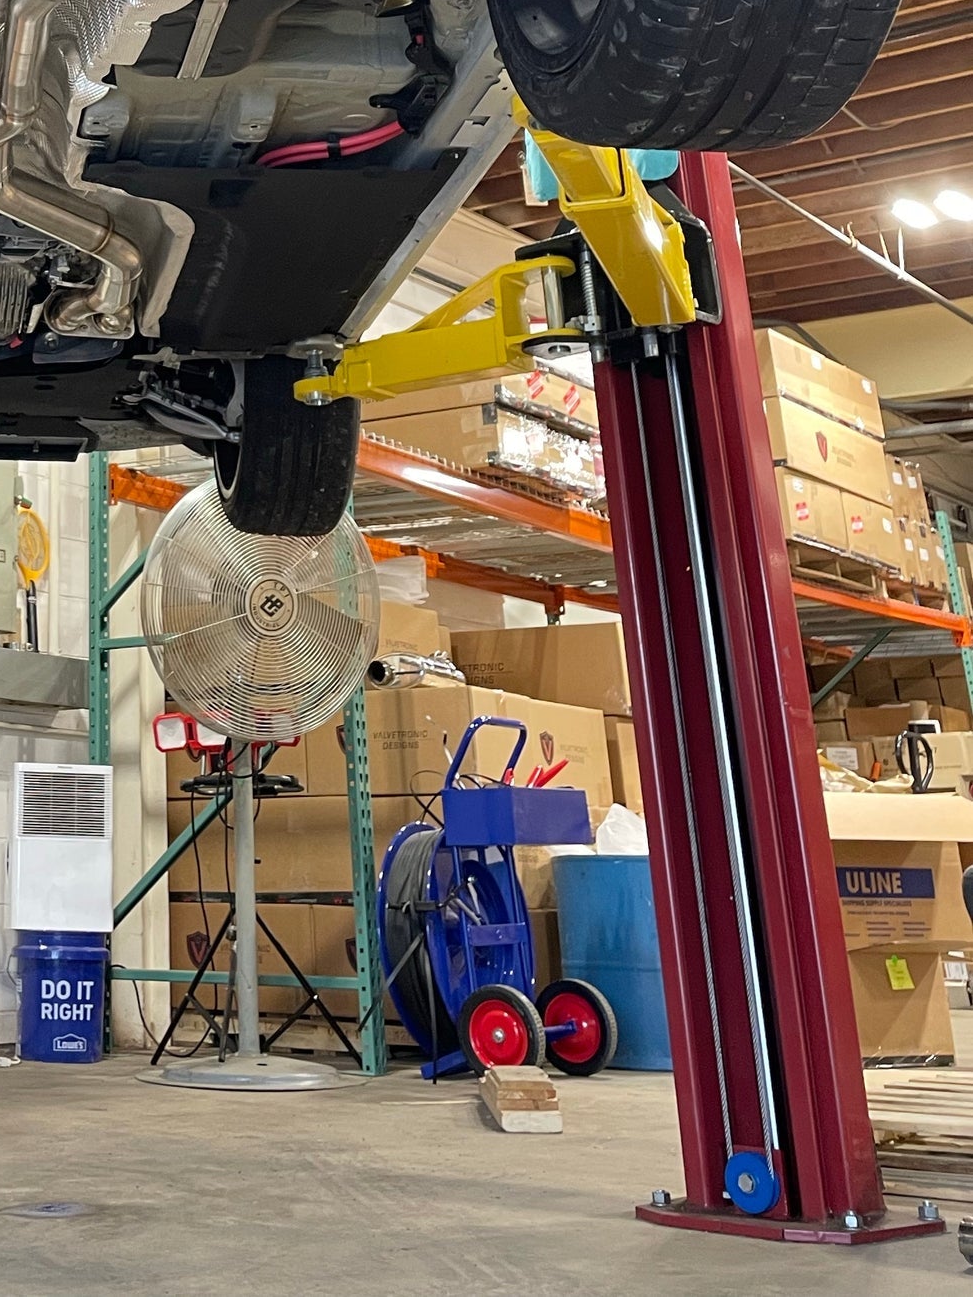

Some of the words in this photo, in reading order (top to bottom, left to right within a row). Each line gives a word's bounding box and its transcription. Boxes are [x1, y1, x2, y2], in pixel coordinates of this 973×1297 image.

[373, 730, 428, 739] VALVETRONIC
[382, 742, 420, 750] DESIGNS
[845, 870, 903, 894] ULINE
[41, 979, 71, 1000] DO
[77, 981, 95, 1000] IT
[41, 1002, 94, 1021] RIGHT
